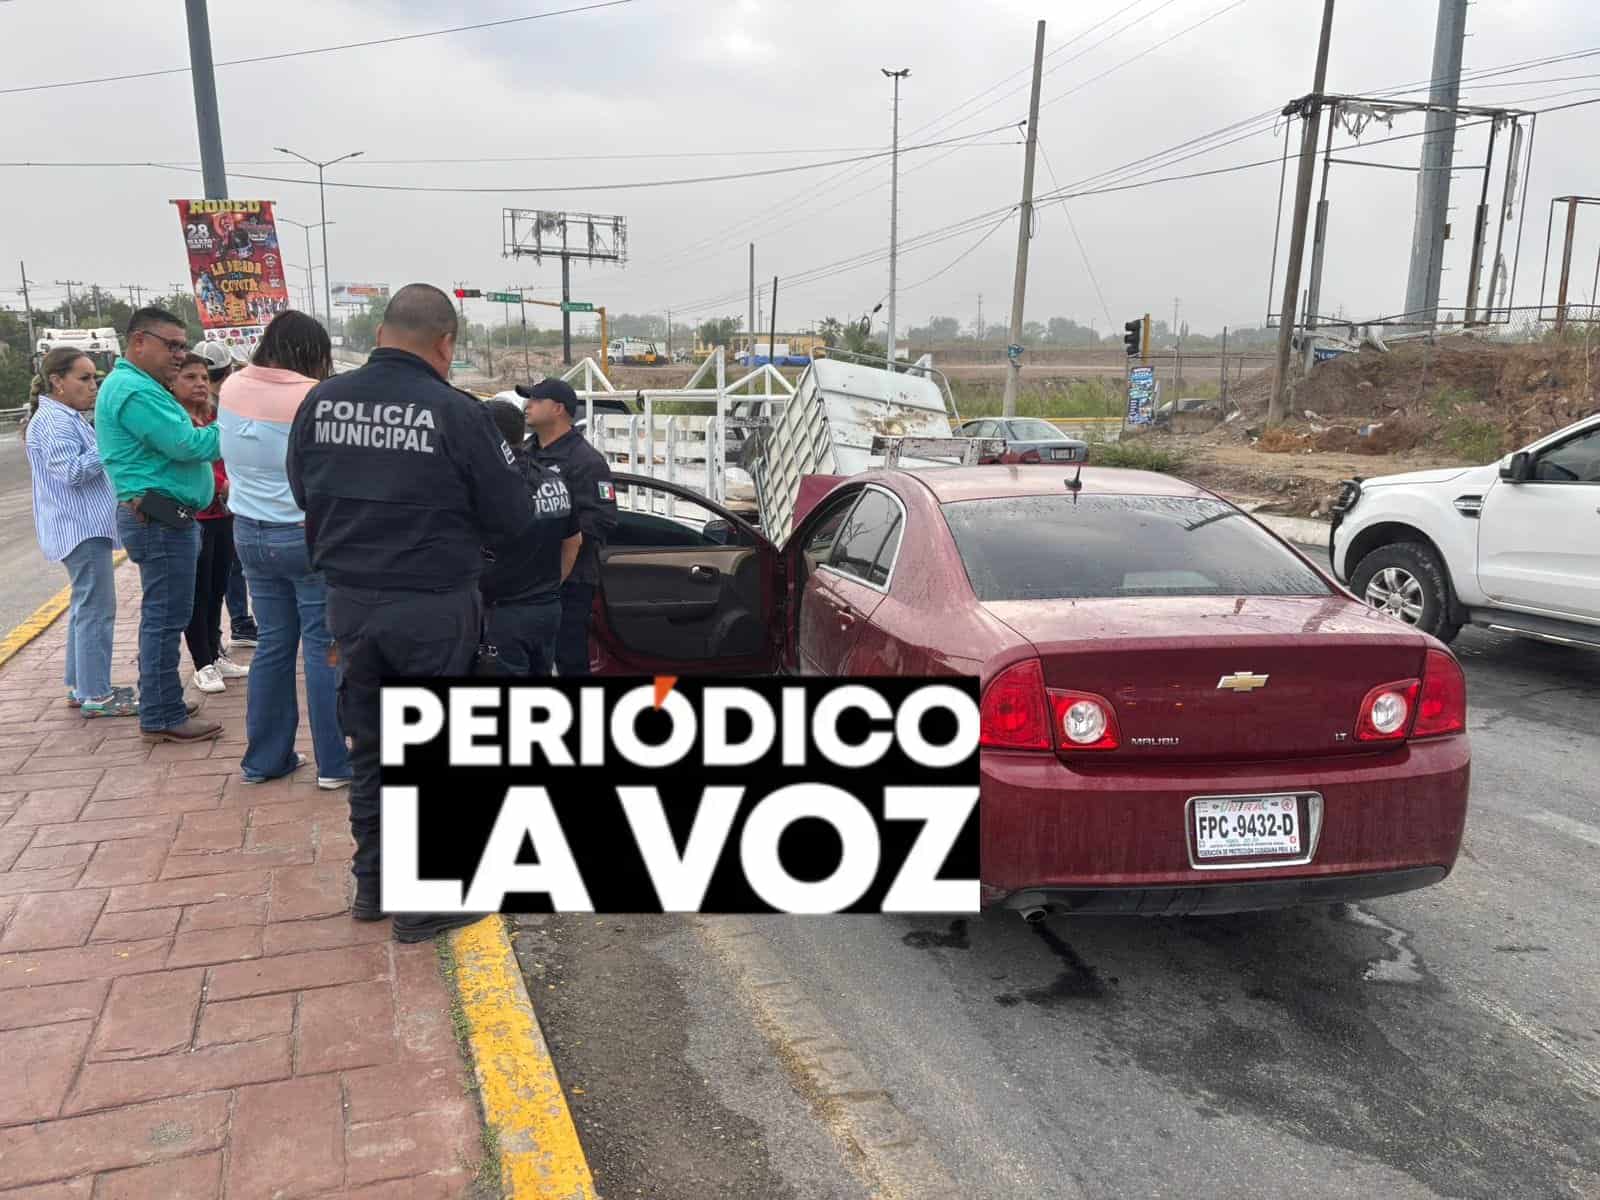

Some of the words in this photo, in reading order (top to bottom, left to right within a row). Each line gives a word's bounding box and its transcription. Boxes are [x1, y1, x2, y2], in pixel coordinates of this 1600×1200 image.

[187, 223, 209, 239] 28
[315, 401, 435, 429] POLICÍA
[315, 421, 434, 453] MUNICIPAL
[1131, 737, 1180, 745] MALIBU
[1335, 732, 1347, 740] LT
